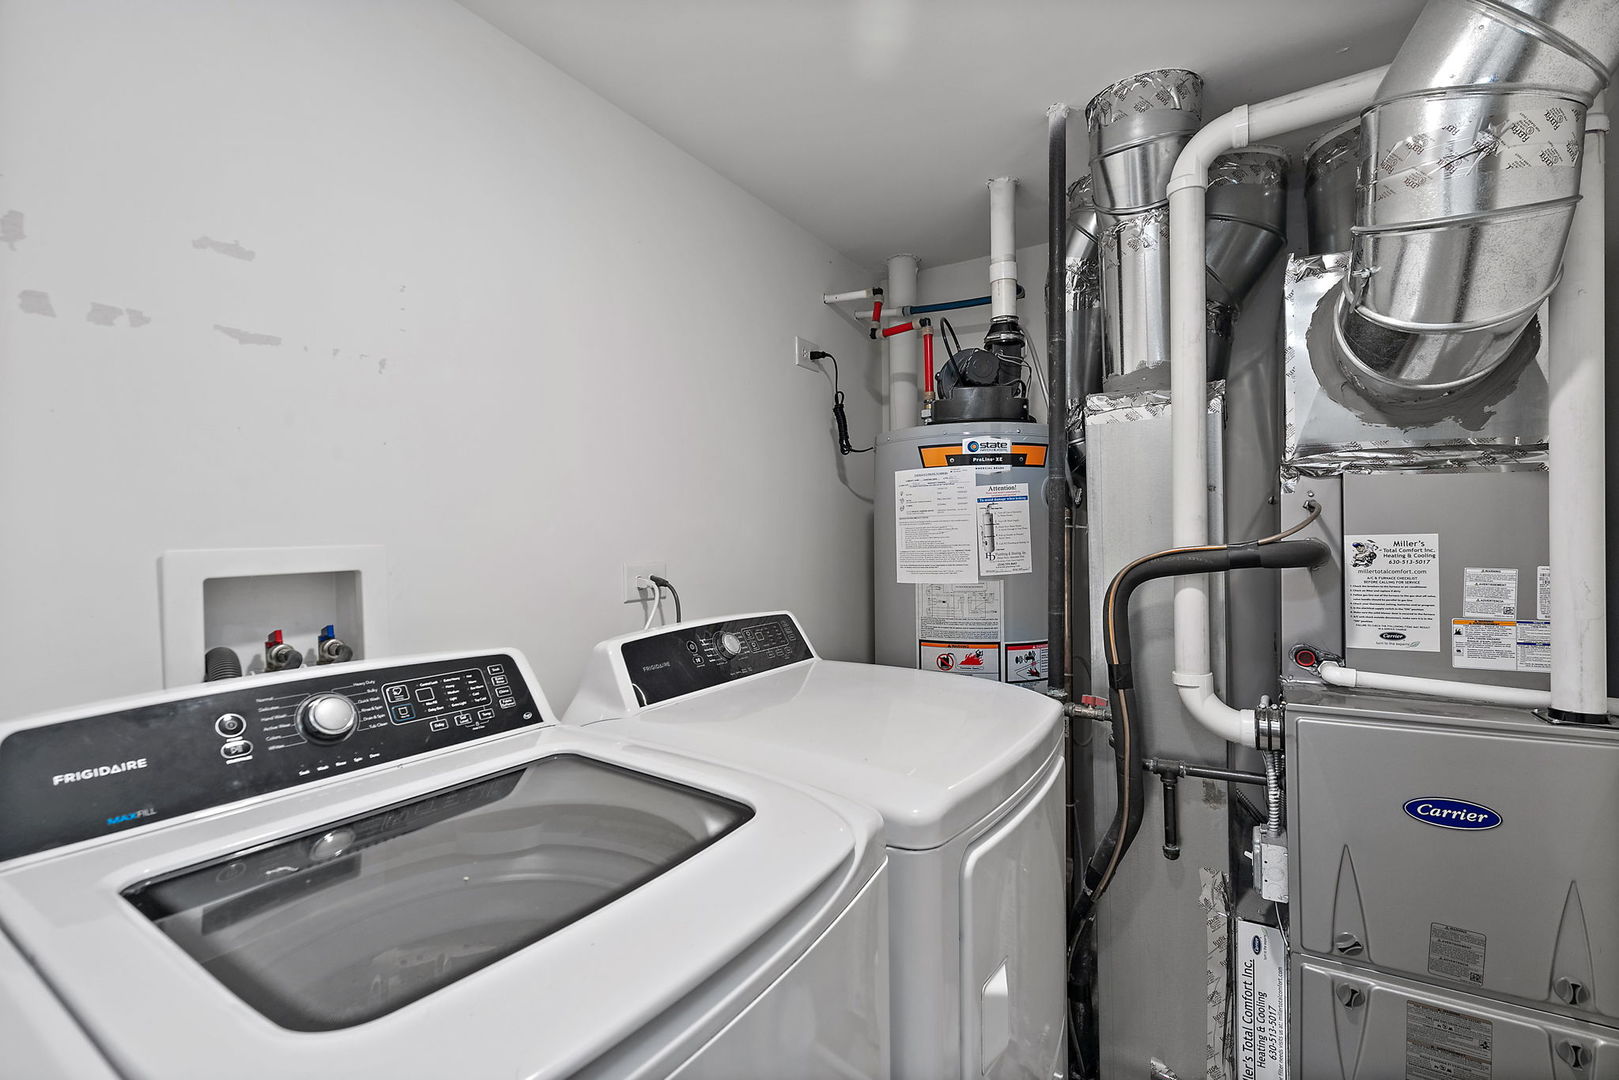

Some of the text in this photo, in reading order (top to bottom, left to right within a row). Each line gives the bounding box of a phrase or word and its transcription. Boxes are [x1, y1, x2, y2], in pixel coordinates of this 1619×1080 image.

[642, 661, 671, 672] FRIGIDAIRE
[52, 758, 148, 786] FRIGIDAIRE
[106, 807, 156, 825] MAXFILL
[1417, 803, 1488, 822] Carrier
[1242, 959, 1253, 978] Inc.
[1242, 981, 1253, 1024] Comfort
[1256, 991, 1267, 1024] Cooling
[1242, 1027, 1253, 1052] Total
[1268, 1005, 1277, 1060] 630-513-5017
[1256, 1036, 1267, 1068] Heating
